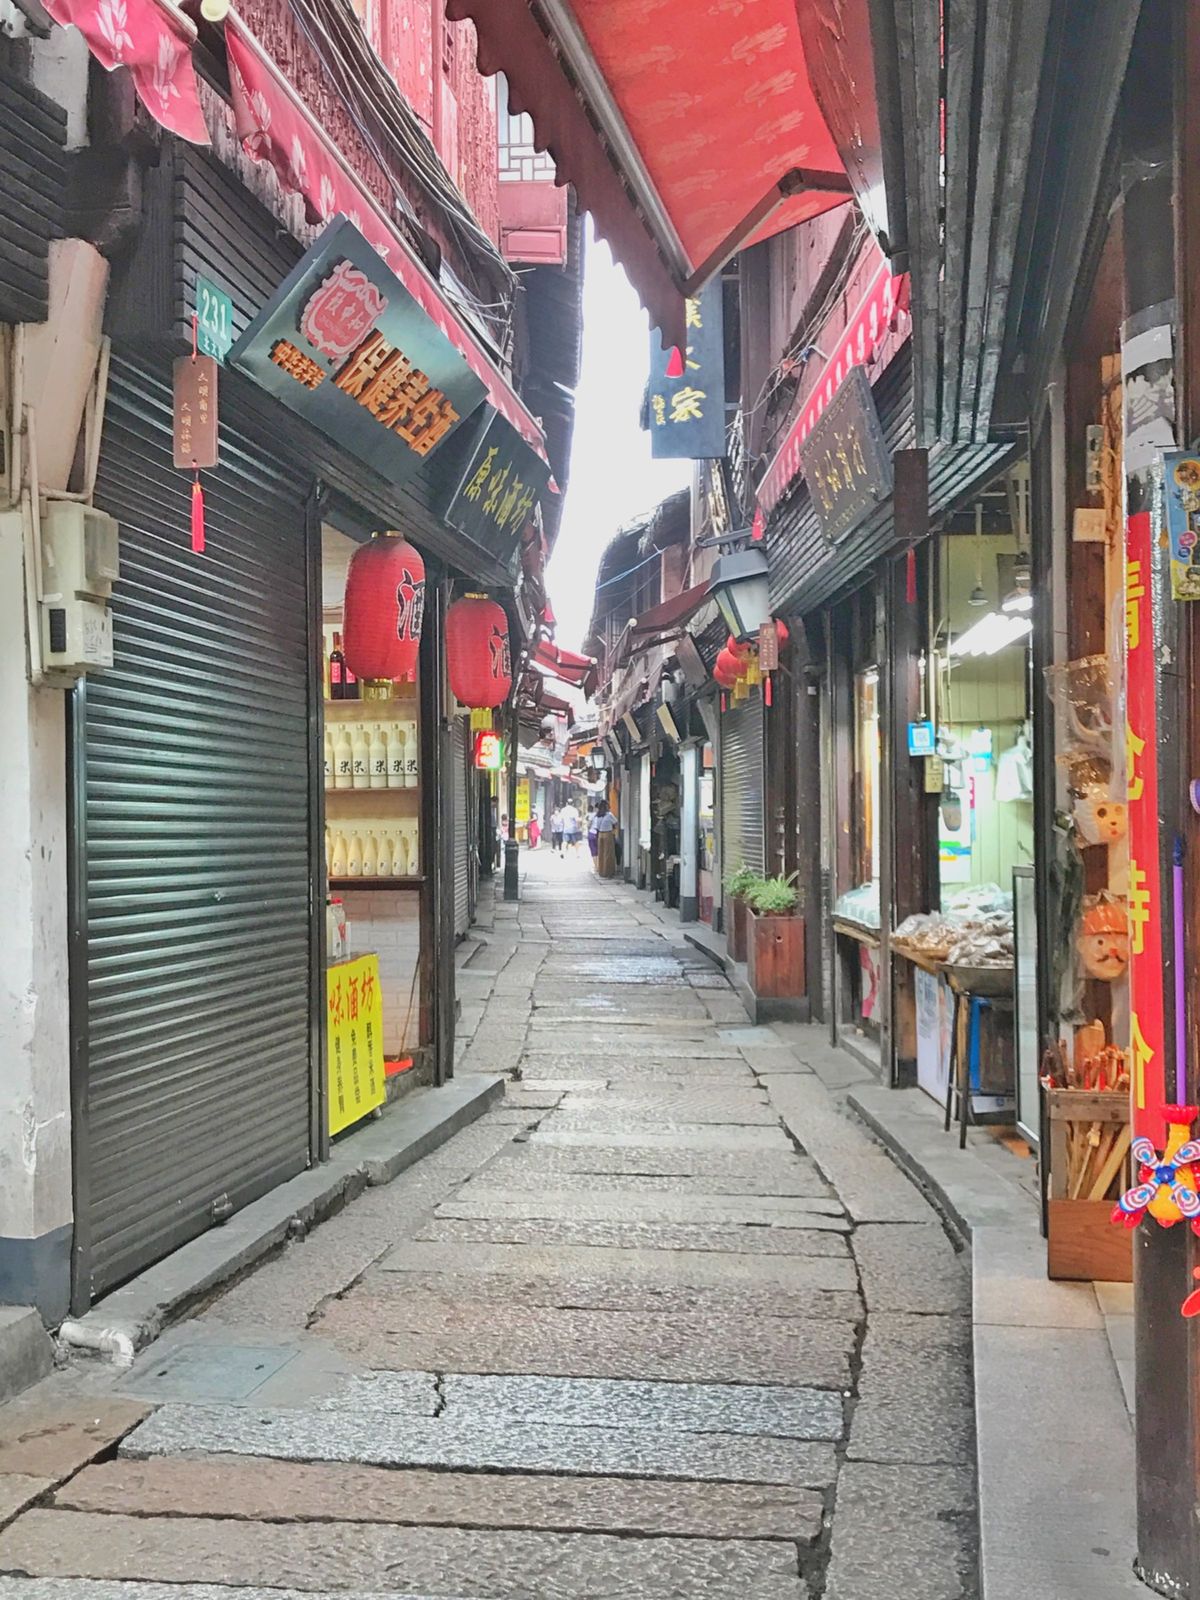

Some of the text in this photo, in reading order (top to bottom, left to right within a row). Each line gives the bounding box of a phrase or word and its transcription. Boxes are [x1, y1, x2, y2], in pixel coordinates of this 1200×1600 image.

[202, 288, 226, 340] 231
[270, 340, 327, 391] 中华老字号
[335, 334, 460, 457] 保健养生酒
[463, 446, 536, 536] 原味酒坊
[340, 761, 351, 774] 米
[354, 761, 365, 773] 米
[376, 760, 386, 773] 米
[393, 760, 404, 773] 米
[407, 760, 418, 773] 米
